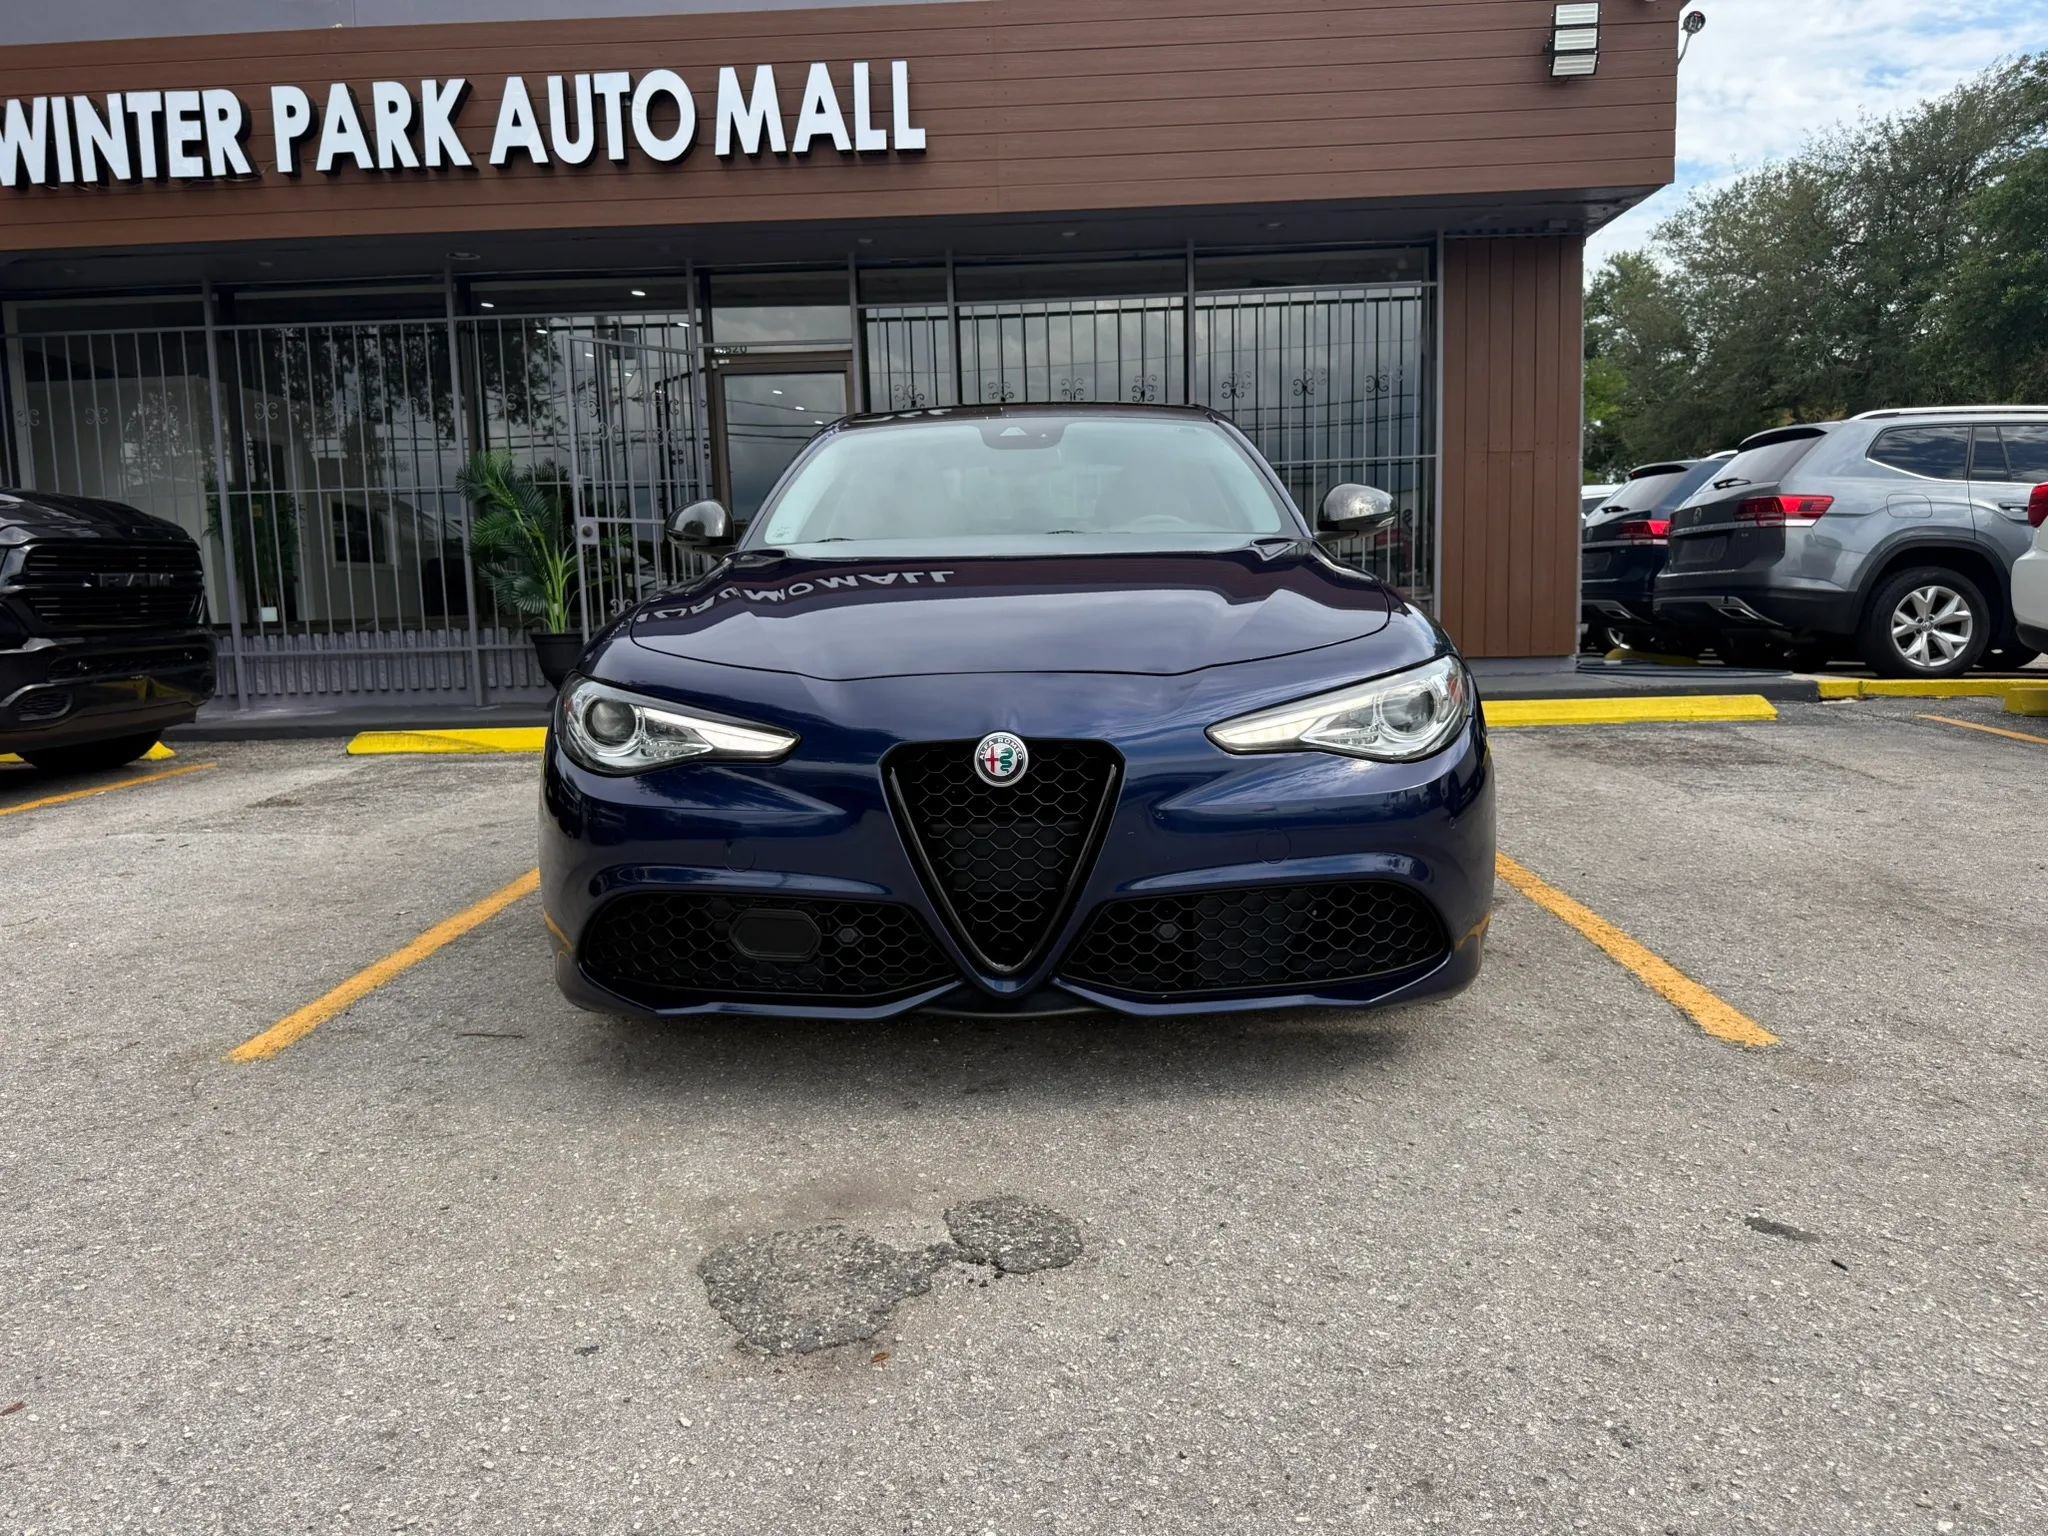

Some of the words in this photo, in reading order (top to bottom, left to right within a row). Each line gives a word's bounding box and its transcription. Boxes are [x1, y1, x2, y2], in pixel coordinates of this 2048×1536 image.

[0, 89, 252, 187] WINTER
[271, 78, 472, 174] PARK
[489, 69, 696, 167] AUTO
[715, 61, 926, 157] MALL
[979, 740, 995, 761] ALFA
[997, 737, 1023, 761] ROMEO
